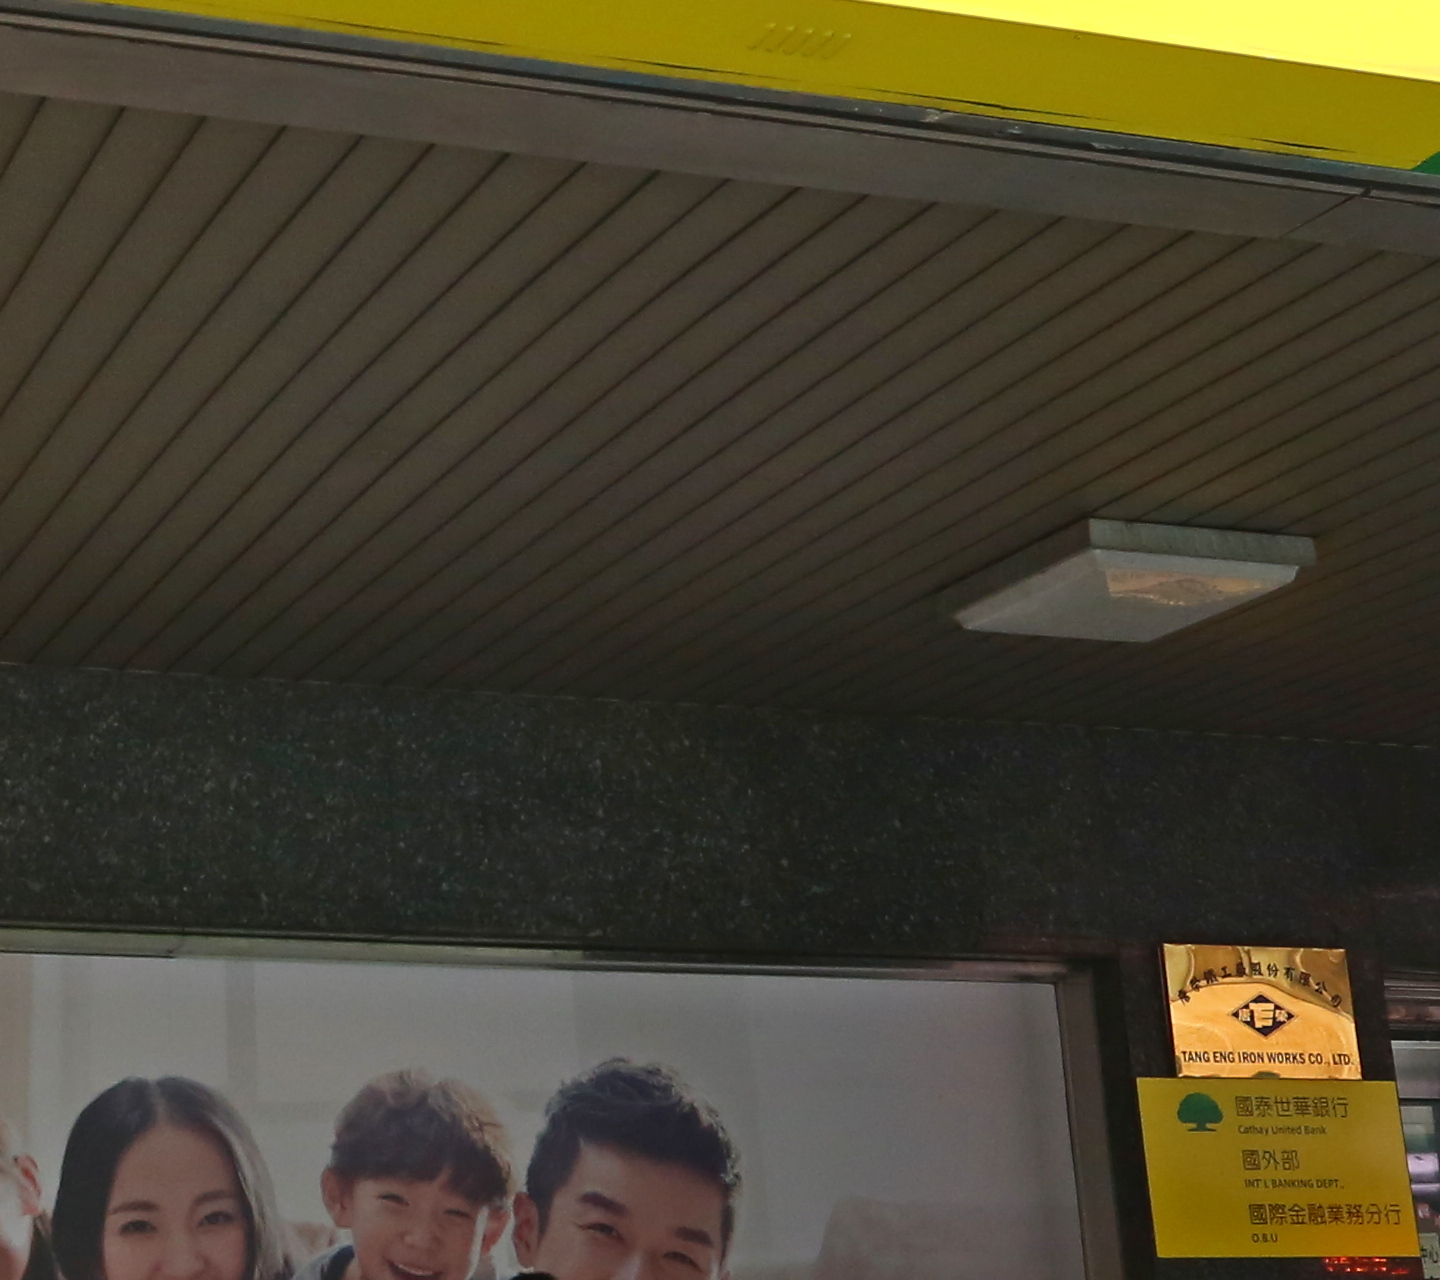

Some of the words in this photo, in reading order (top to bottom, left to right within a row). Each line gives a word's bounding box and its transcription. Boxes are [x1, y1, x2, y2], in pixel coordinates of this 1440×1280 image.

[1180, 1050, 1210, 1064] TANG
[1212, 1050, 1236, 1064] ENG
[1237, 1051, 1265, 1064] IRON
[1267, 1051, 1306, 1065] WORKS
[1234, 1095, 1350, 1119] 國泰世華銀行
[1237, 1124, 1270, 1137] Cathay
[1271, 1125, 1302, 1136] United
[1303, 1125, 1328, 1136] Bank
[1241, 1148, 1301, 1172] 國外部
[1270, 1178, 1314, 1190] BANKING
[1248, 1202, 1402, 1227] 國際金融業務分行
